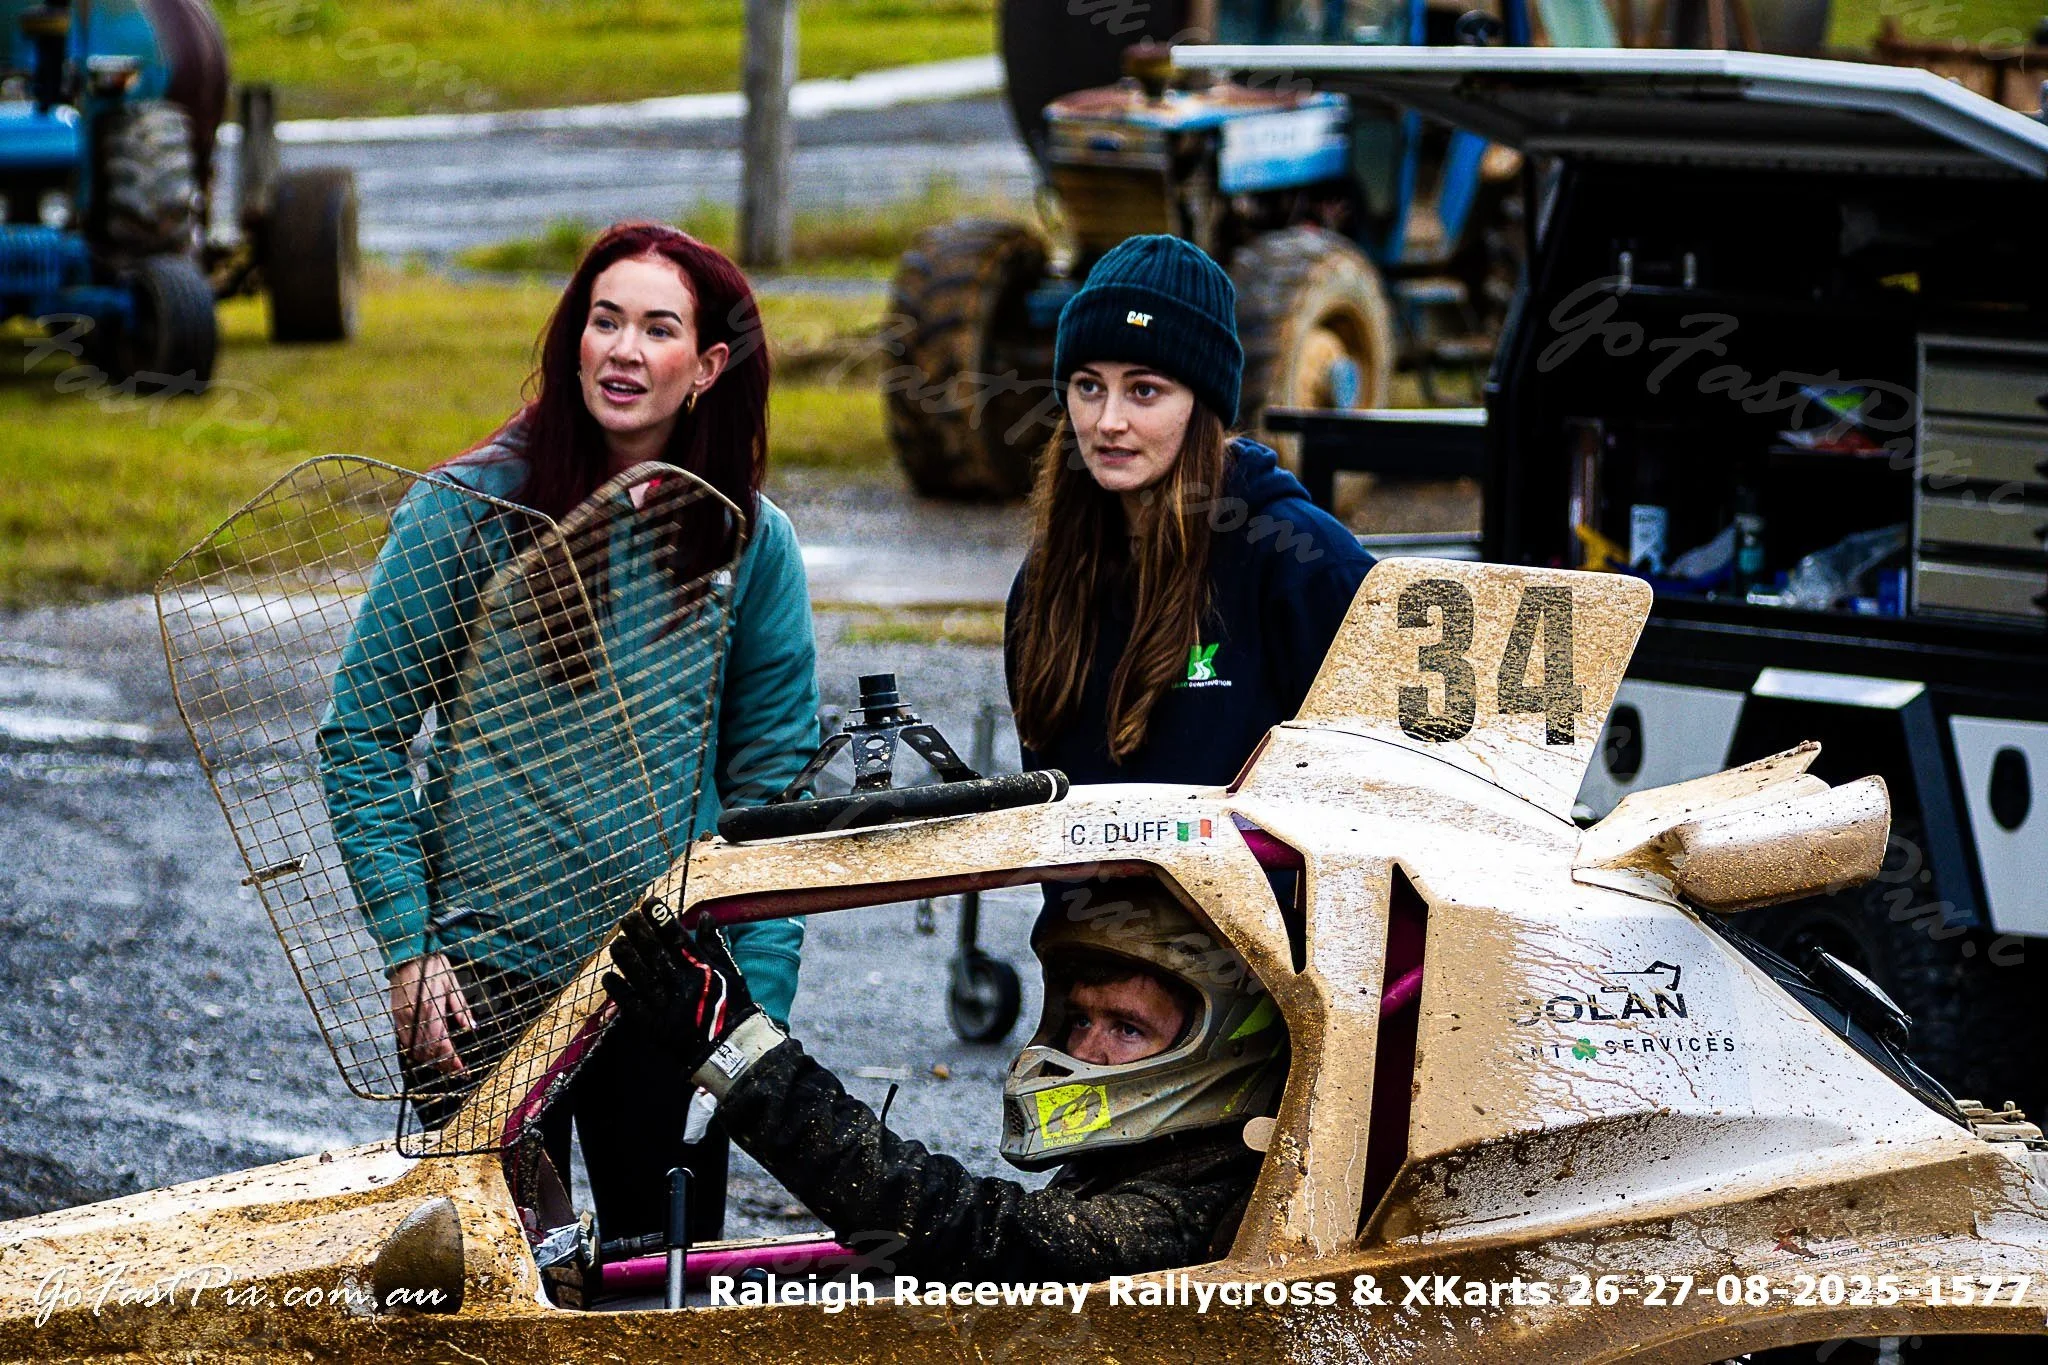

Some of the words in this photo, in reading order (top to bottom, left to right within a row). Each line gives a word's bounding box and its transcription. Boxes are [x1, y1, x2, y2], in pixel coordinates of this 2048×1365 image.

[1126, 310, 1153, 327] CAT
[1397, 578, 1583, 746] 34
[1070, 824, 1093, 846] C.
[1104, 820, 1169, 844] DUFF
[1604, 1036, 1736, 1056] SERVICES
